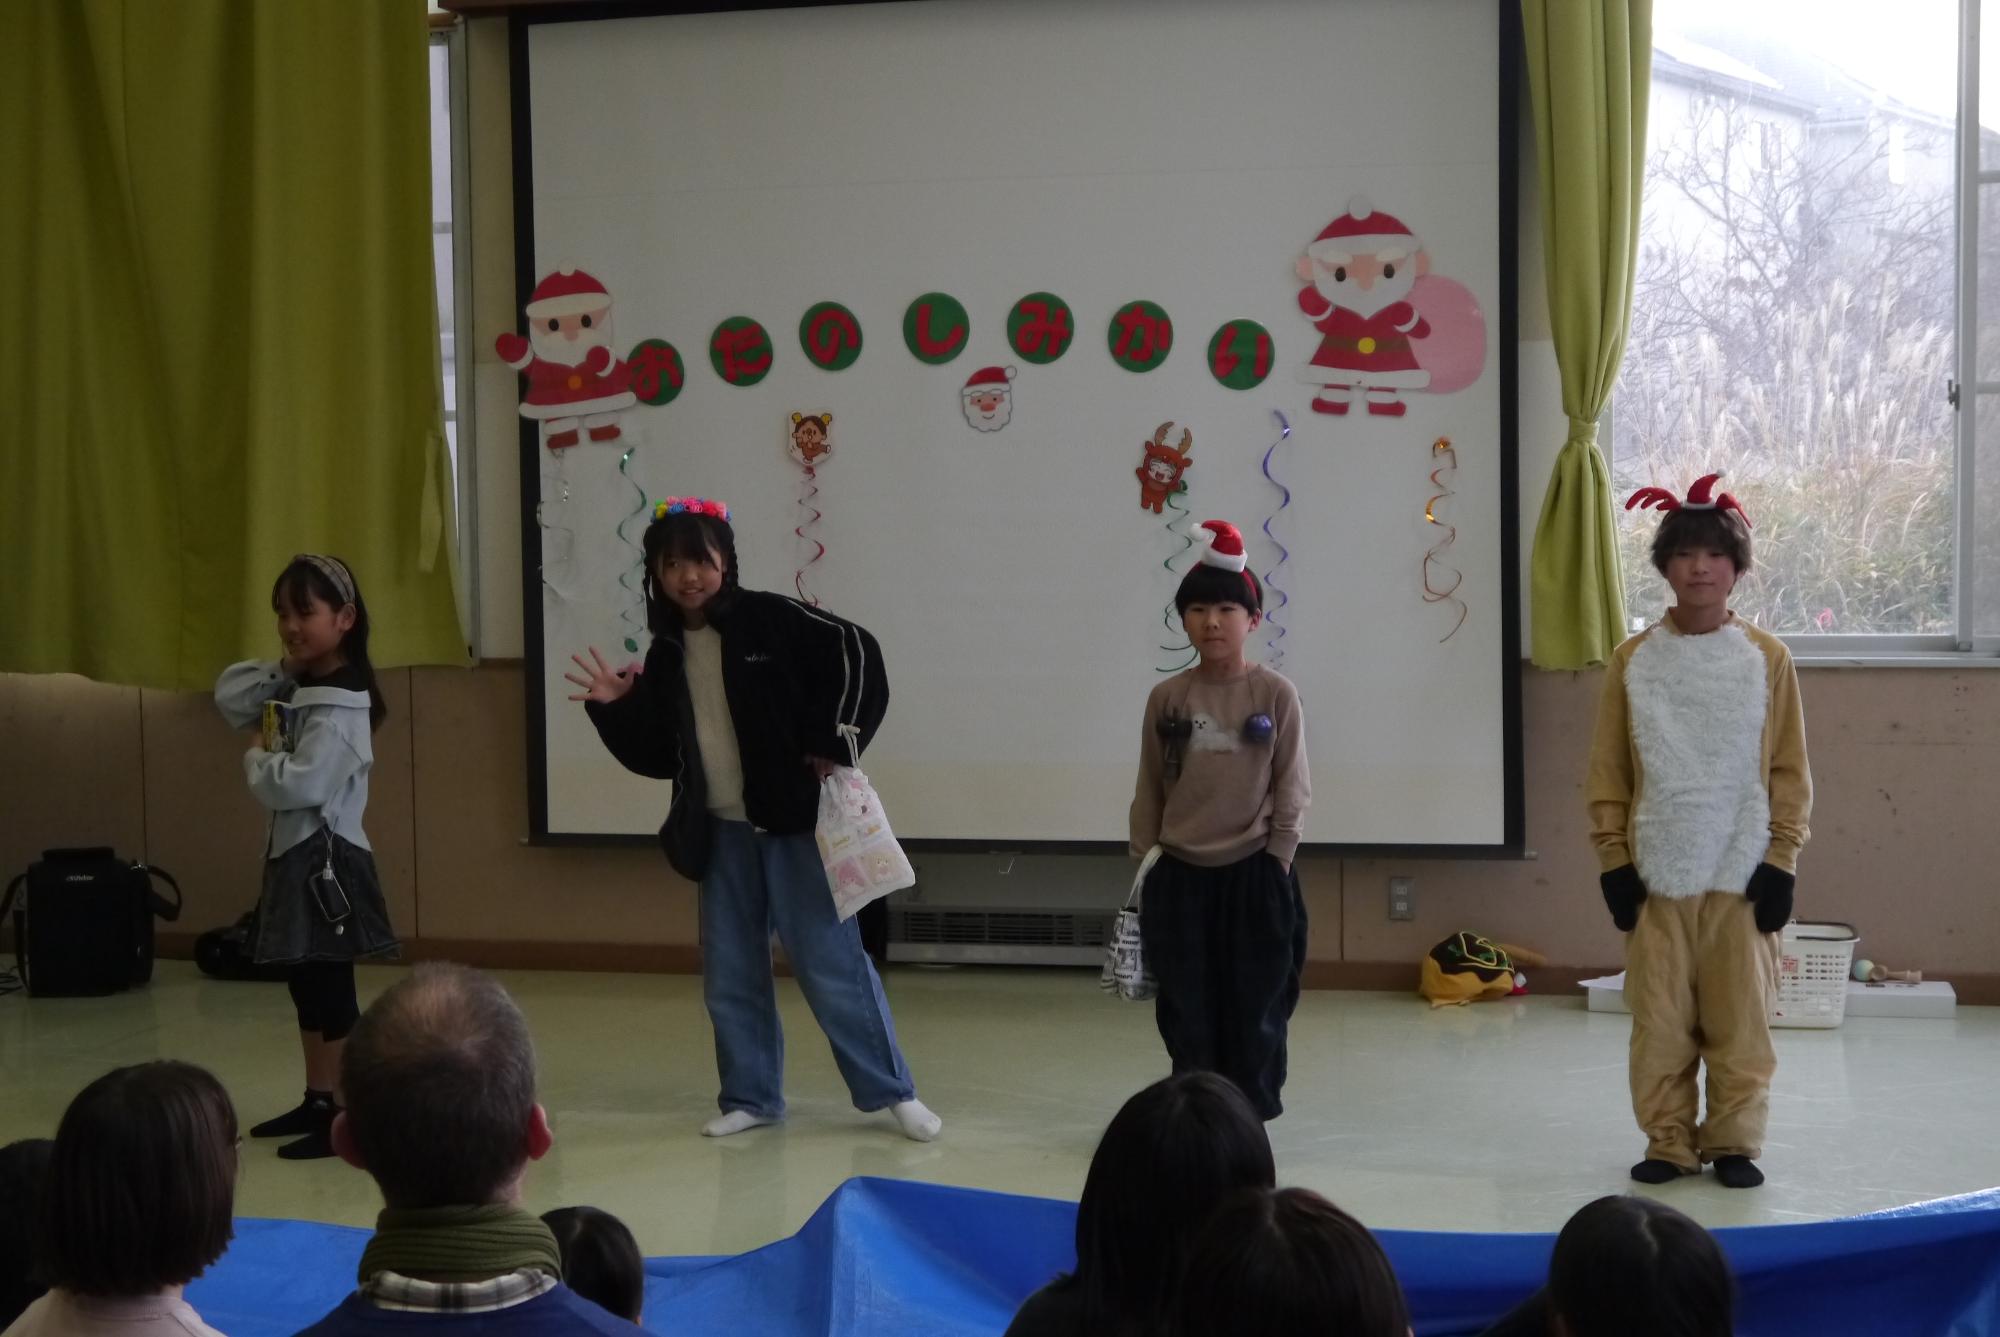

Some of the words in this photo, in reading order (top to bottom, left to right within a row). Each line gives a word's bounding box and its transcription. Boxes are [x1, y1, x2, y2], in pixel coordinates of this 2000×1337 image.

[629, 302, 1270, 400] おたのしみかい
